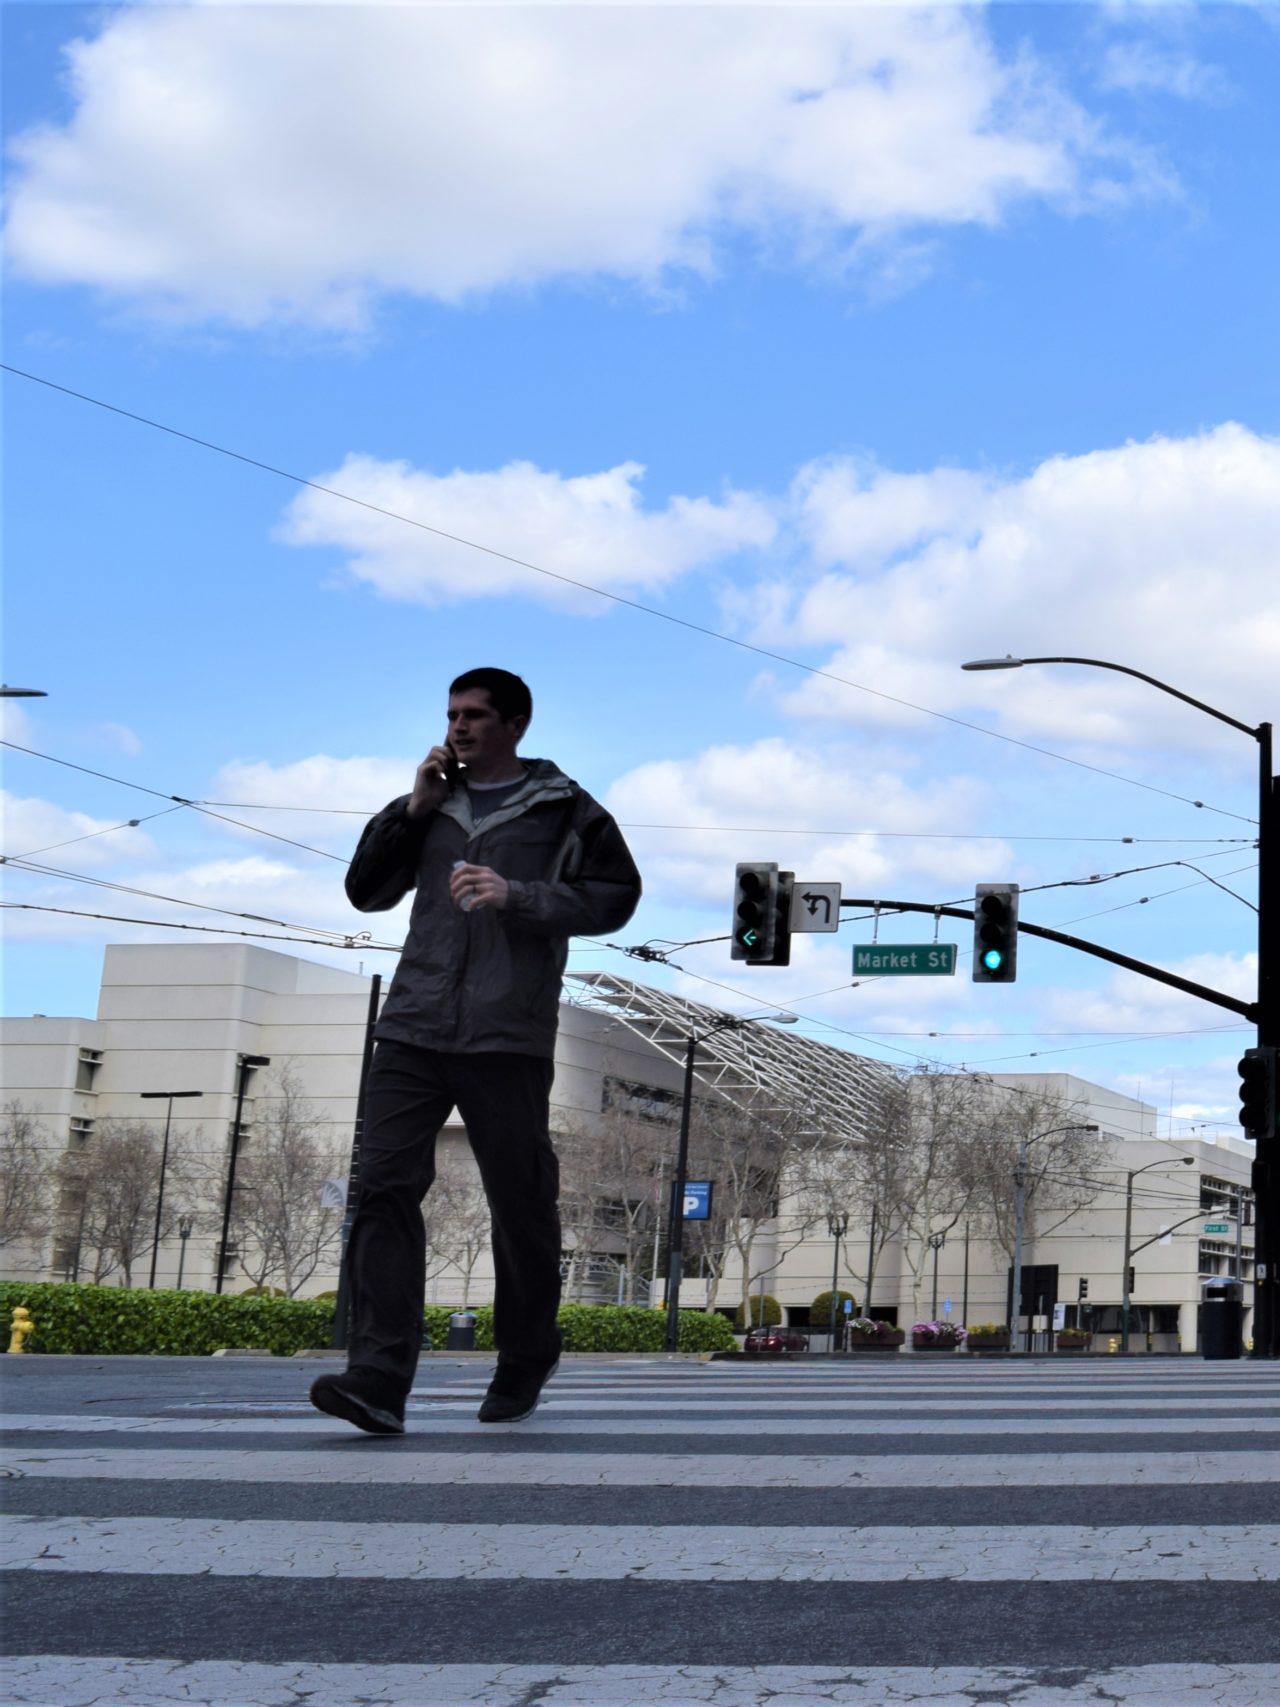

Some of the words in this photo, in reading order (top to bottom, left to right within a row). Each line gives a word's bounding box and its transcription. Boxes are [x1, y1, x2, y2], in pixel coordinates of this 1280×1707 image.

[858, 952, 918, 968] Market
[928, 951, 948, 968] St
[683, 1196, 699, 1215] P
